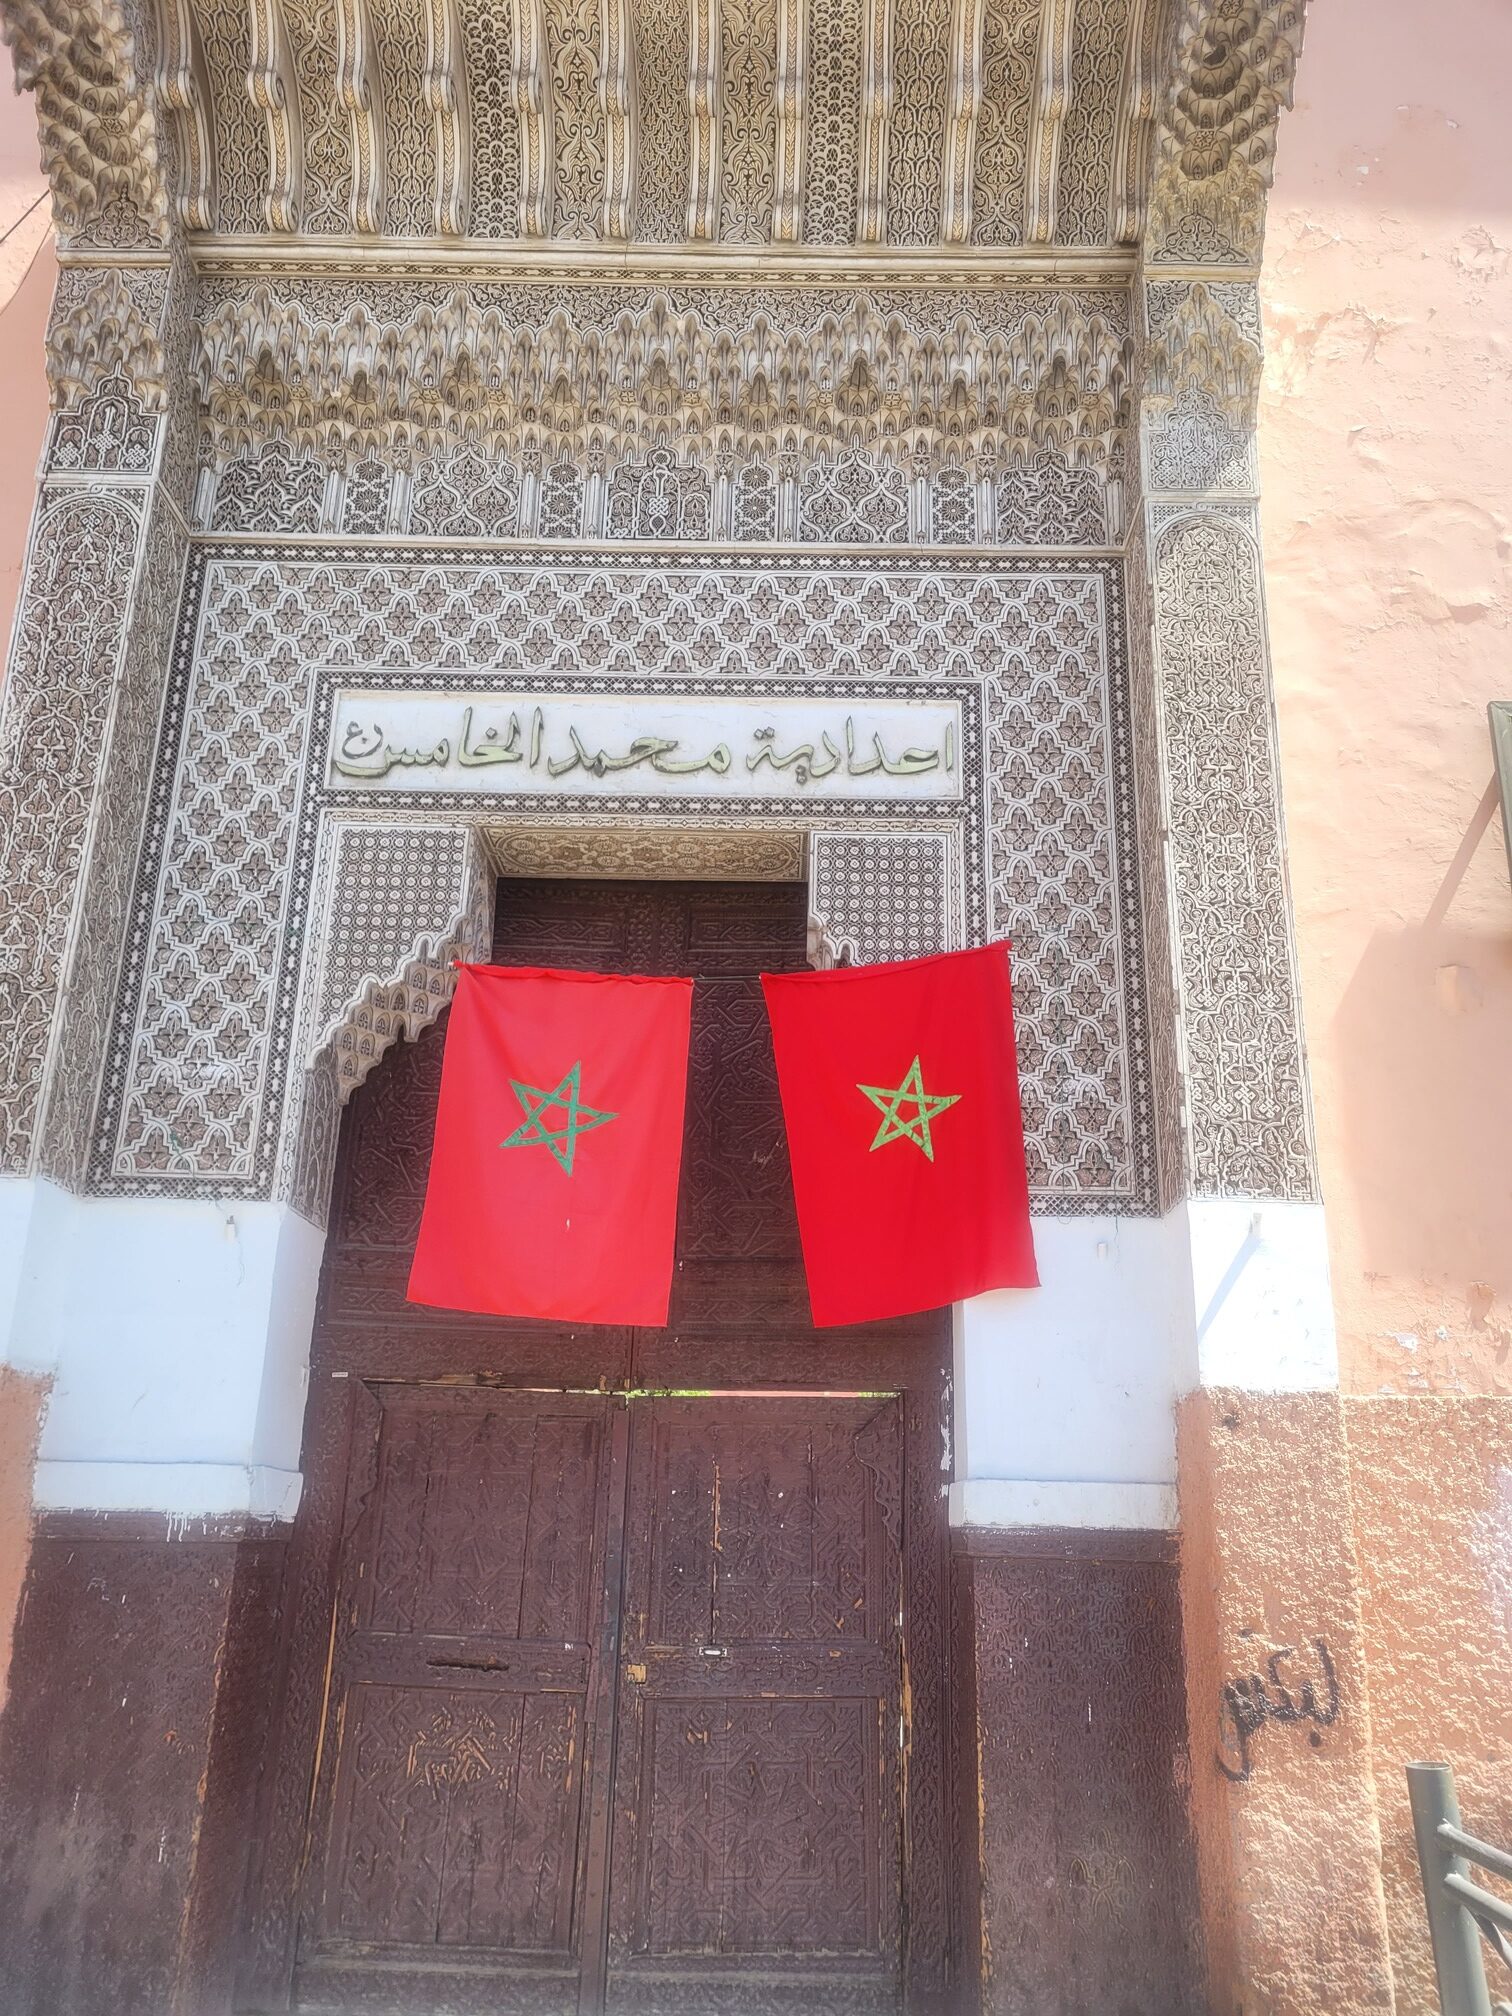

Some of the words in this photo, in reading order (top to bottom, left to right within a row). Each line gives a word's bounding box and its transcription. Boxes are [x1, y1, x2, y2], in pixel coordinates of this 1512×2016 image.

[335, 706, 544, 778] الخامس
[548, 725, 731, 777] محمد
[746, 715, 953, 785] اعدادية
